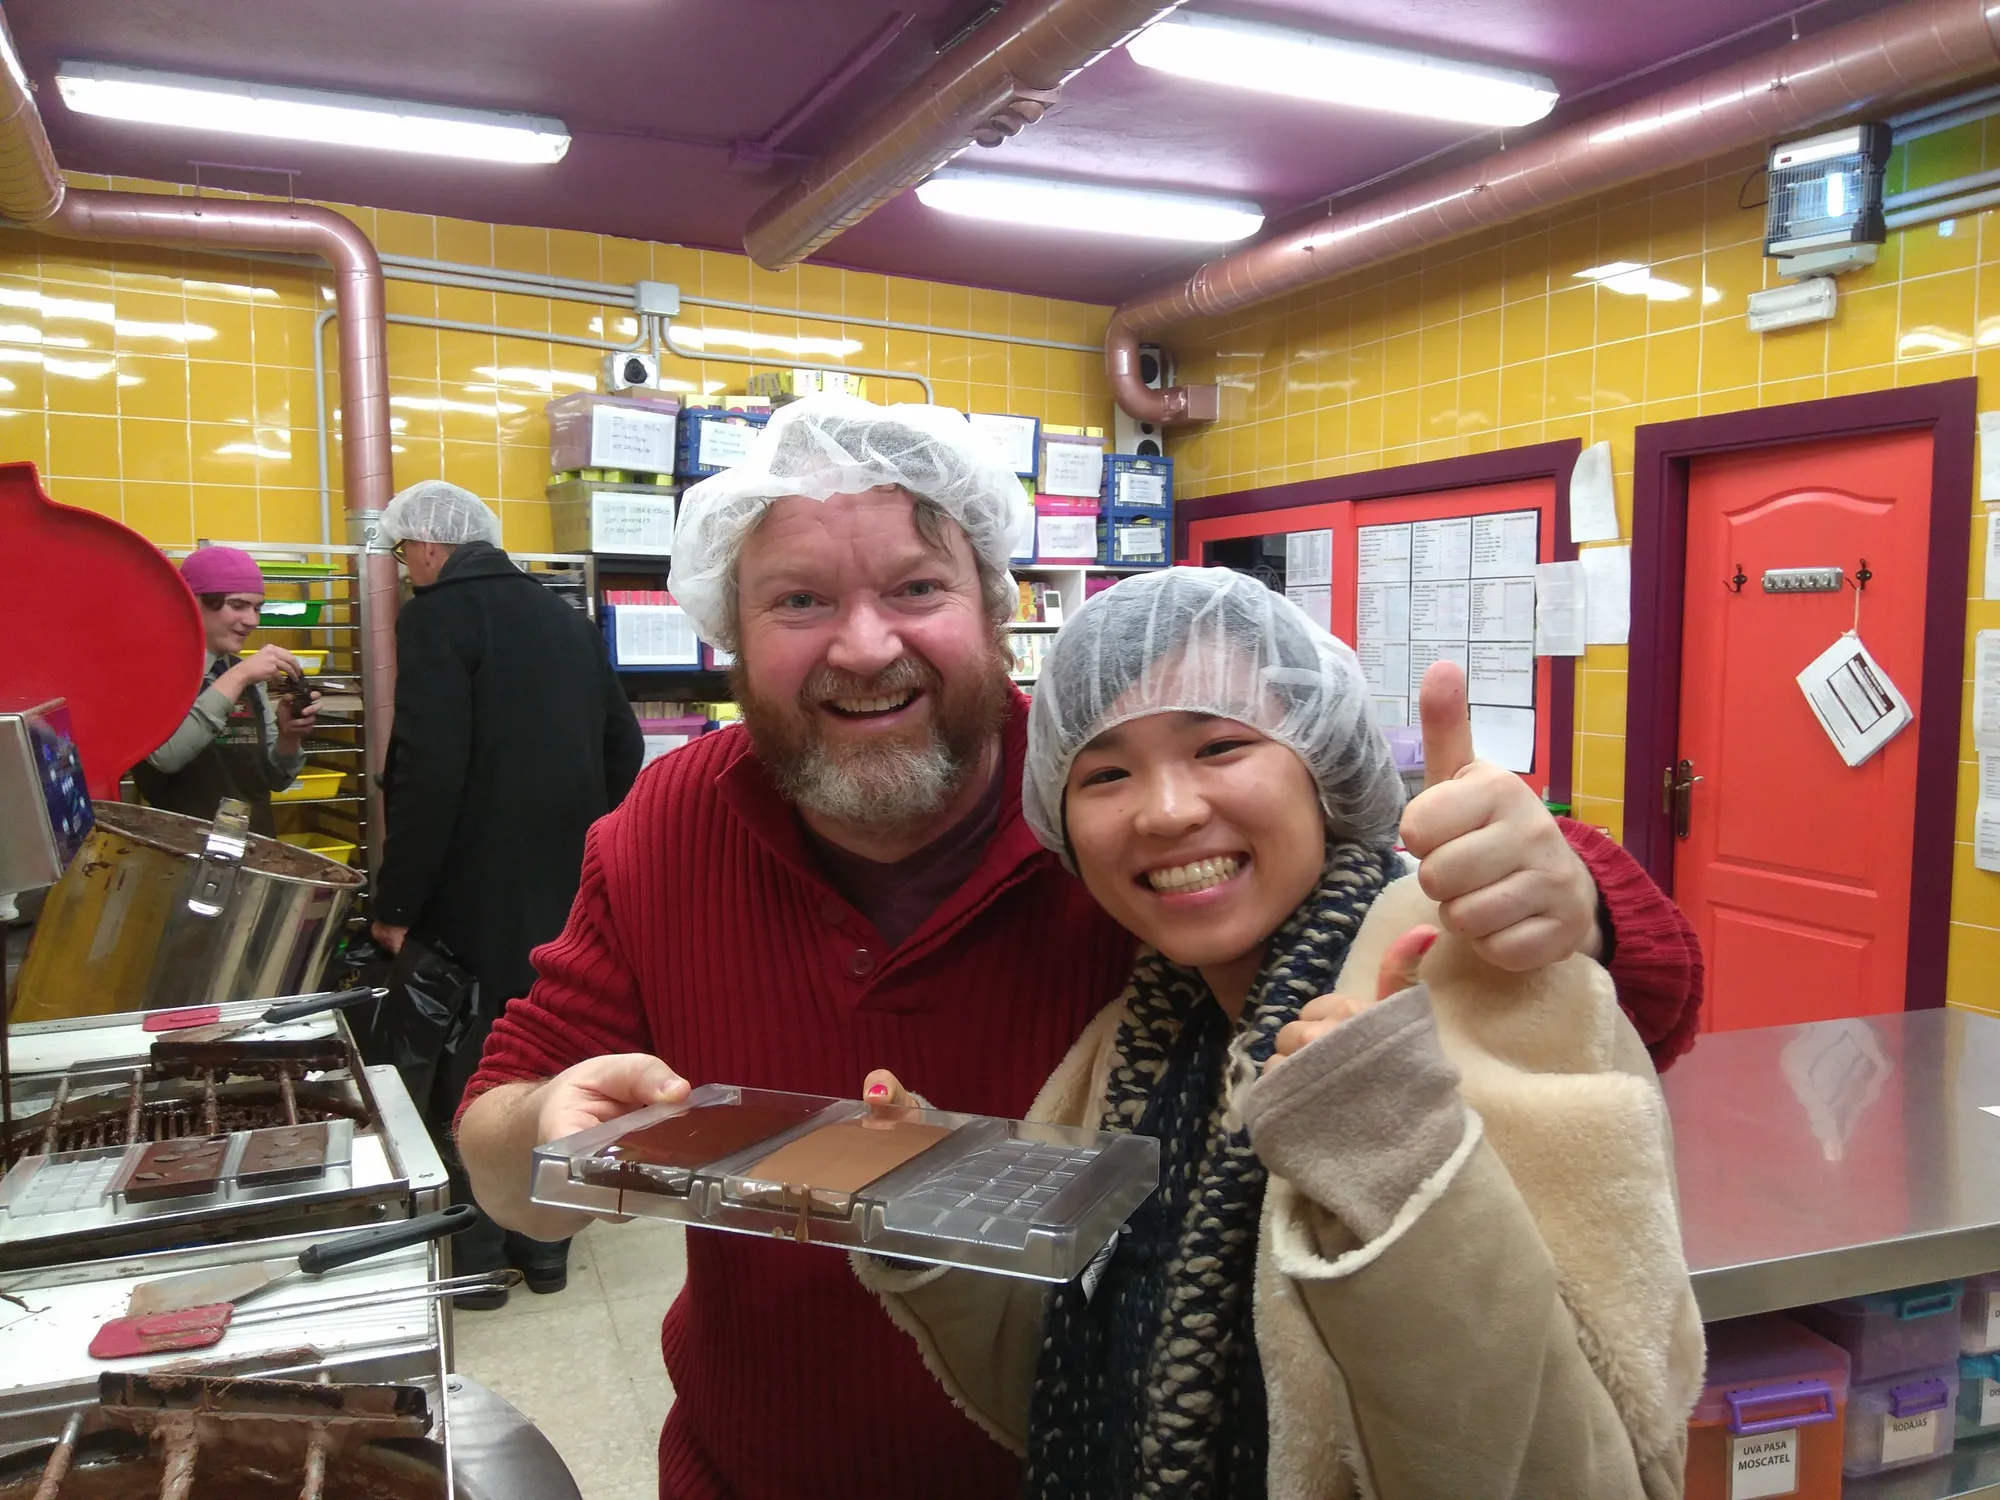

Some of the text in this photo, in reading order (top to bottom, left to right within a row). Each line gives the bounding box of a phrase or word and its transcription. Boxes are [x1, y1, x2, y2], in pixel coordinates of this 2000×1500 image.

[1893, 1418, 1927, 1432] RODAJAS
[1743, 1441, 1787, 1456] UVA PASA
[1738, 1454, 1791, 1470] MOSCATEL
